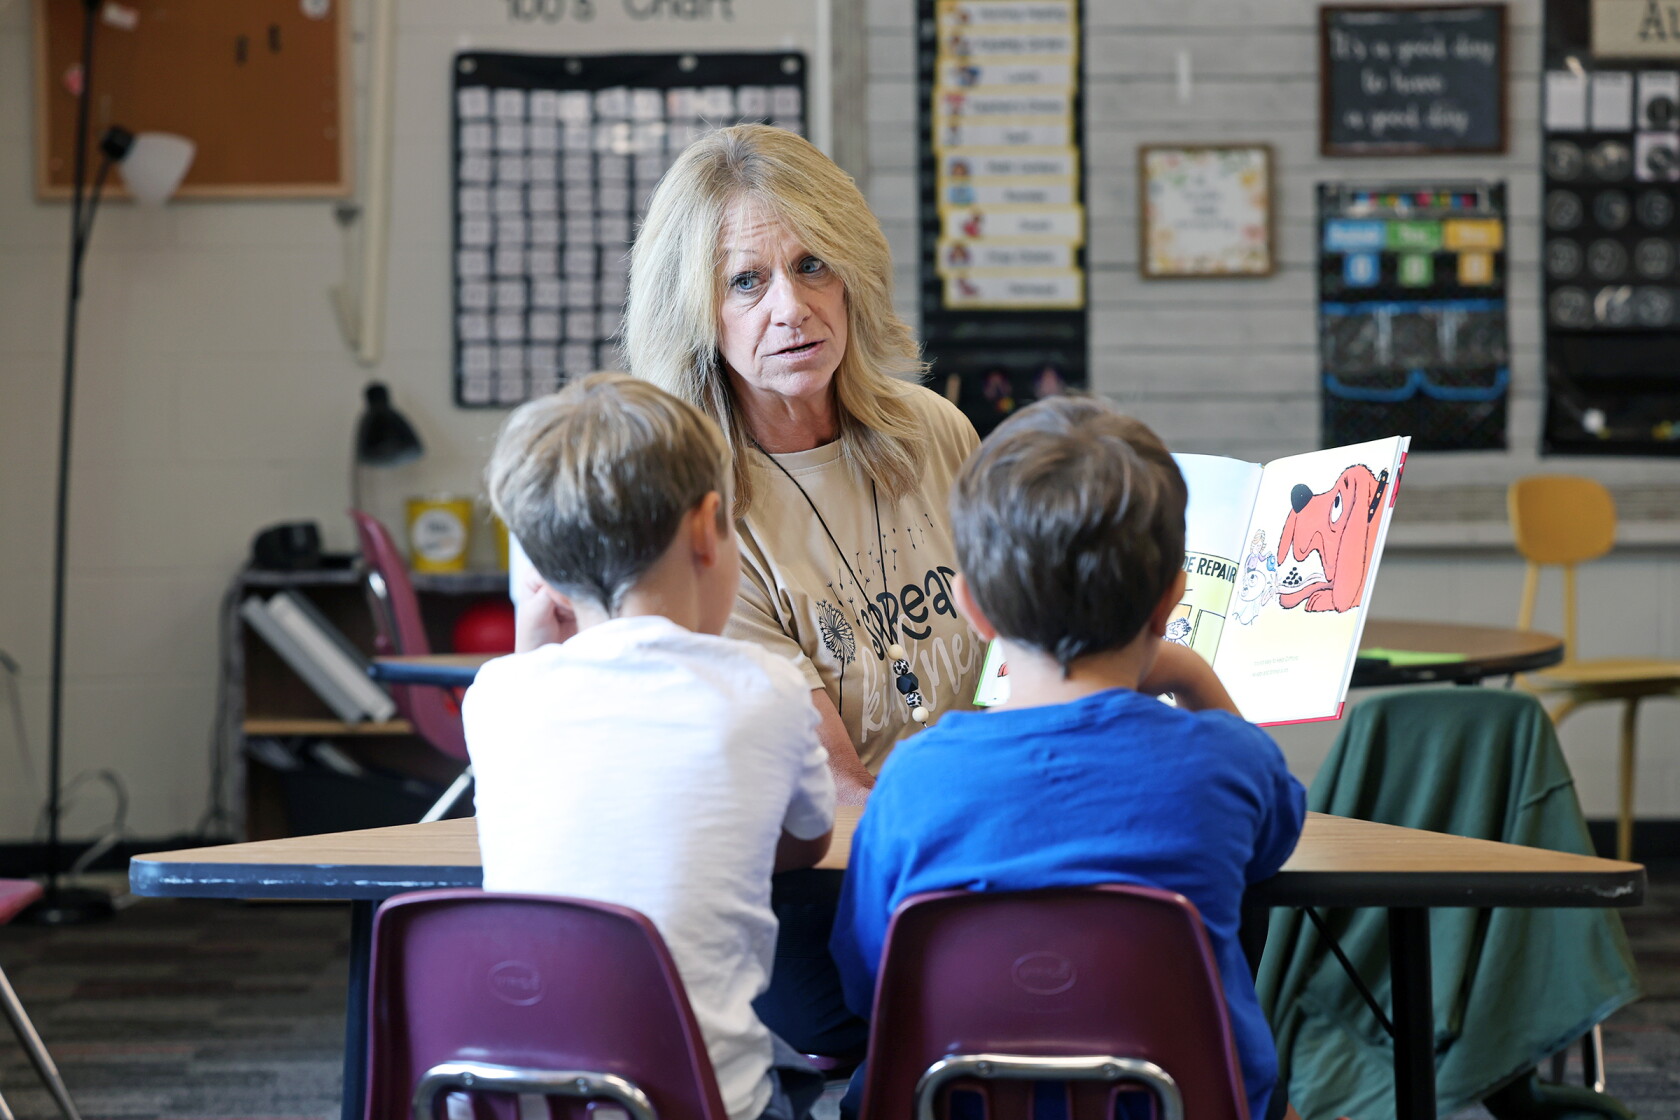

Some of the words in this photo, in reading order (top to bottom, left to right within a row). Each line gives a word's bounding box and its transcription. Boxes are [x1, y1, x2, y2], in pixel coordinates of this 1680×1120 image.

[1372, 40, 1391, 60] a
[1398, 33, 1447, 66] good
[1453, 34, 1496, 67] day
[1361, 68, 1387, 95] to
[1391, 67, 1445, 95] have
[1344, 110, 1364, 130] a
[1371, 102, 1421, 136] good
[1426, 102, 1469, 137] day
[1196, 557, 1237, 584] REPAIR
